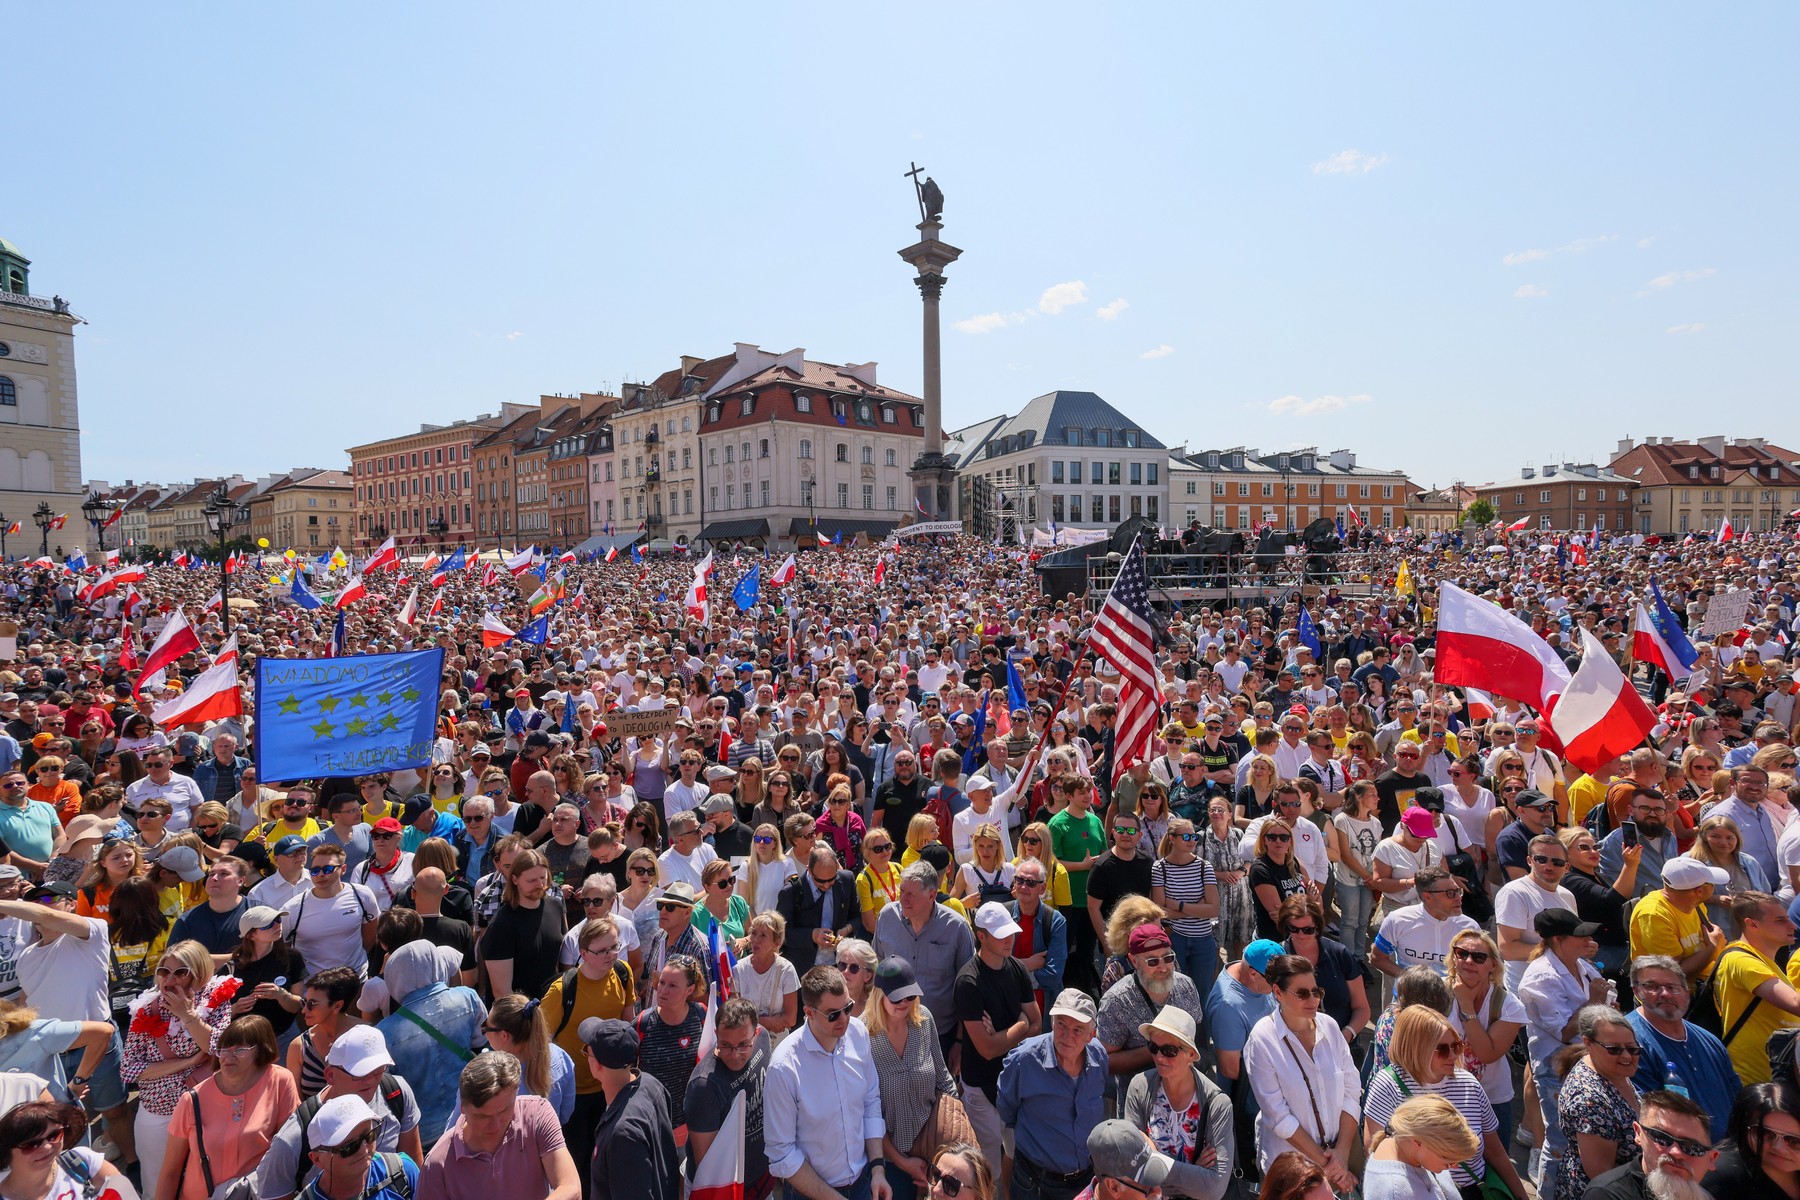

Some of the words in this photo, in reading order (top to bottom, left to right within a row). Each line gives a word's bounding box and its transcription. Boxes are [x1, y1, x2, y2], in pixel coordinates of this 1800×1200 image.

[265, 664, 369, 684] WIADOMO
[631, 709, 673, 720] PREZYDENT
[622, 721, 671, 733] IDEOLOGIA
